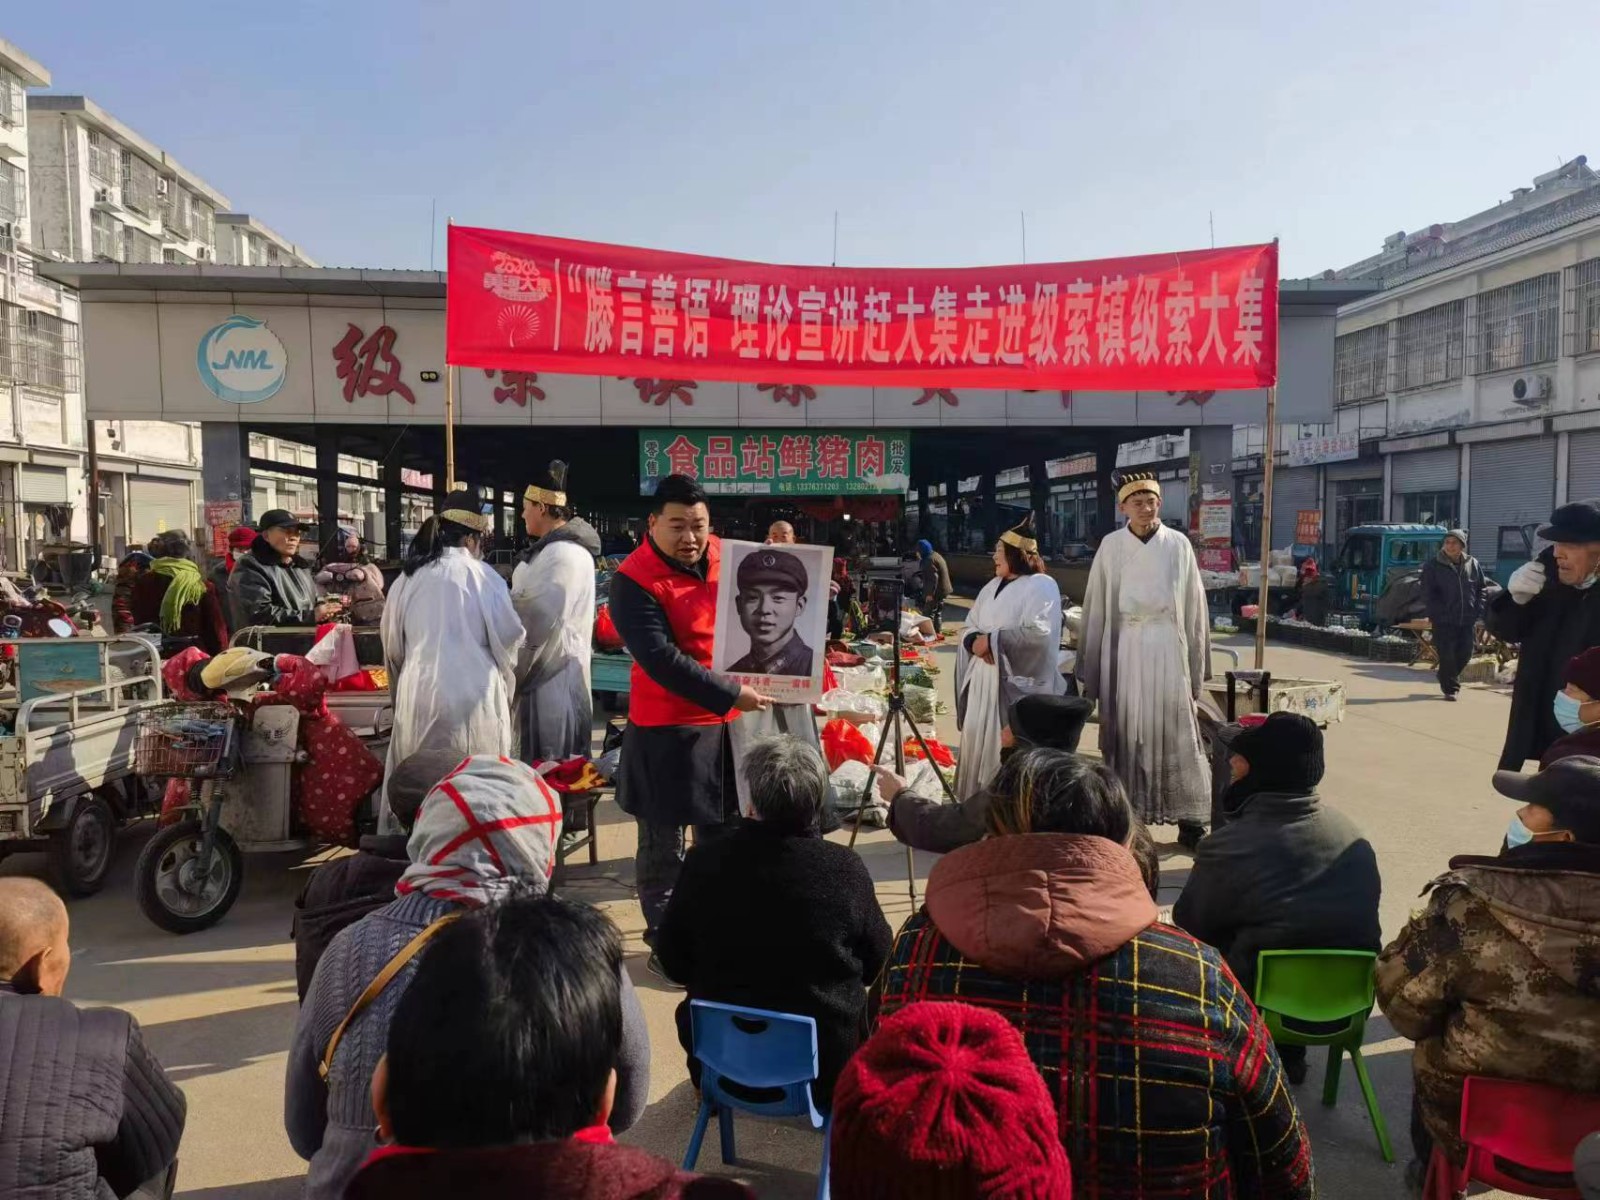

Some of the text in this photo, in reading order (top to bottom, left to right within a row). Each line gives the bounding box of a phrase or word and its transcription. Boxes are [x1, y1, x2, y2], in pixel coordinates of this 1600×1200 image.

[645, 440, 660, 477] 零售
[665, 434, 886, 479] 食品站鲜猪肉
[890, 440, 906, 475] 批发
